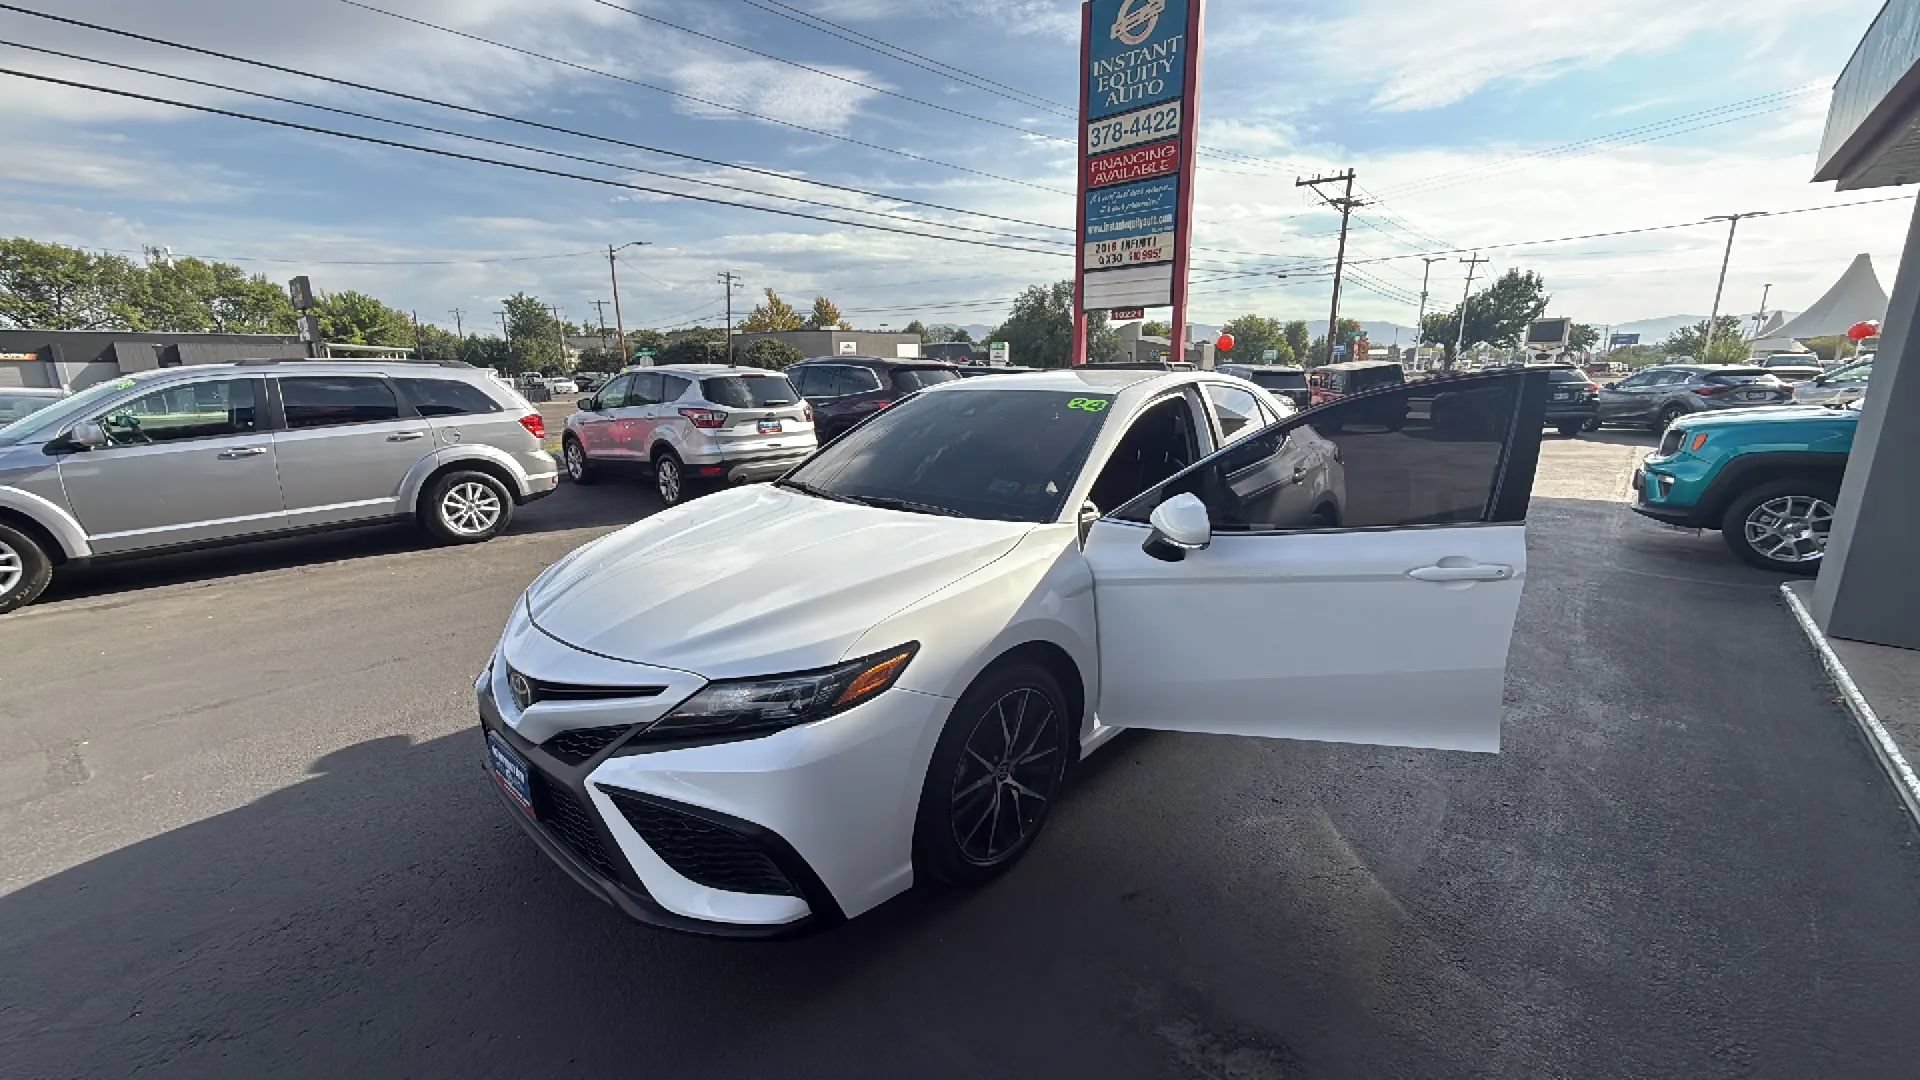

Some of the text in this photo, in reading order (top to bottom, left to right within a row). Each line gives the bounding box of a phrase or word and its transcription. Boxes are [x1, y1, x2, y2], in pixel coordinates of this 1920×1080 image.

[1093, 35, 1183, 77] INSTANT
[1097, 56, 1175, 93] EQUITY
[1105, 79, 1164, 107] AUTO
[1091, 107, 1177, 147] 378-4422
[1091, 146, 1176, 173] FINANCING
[1094, 160, 1171, 184] AVAILABLE
[1096, 236, 1157, 254] 2018 INFINITI
[1068, 398, 1108, 412] 24
